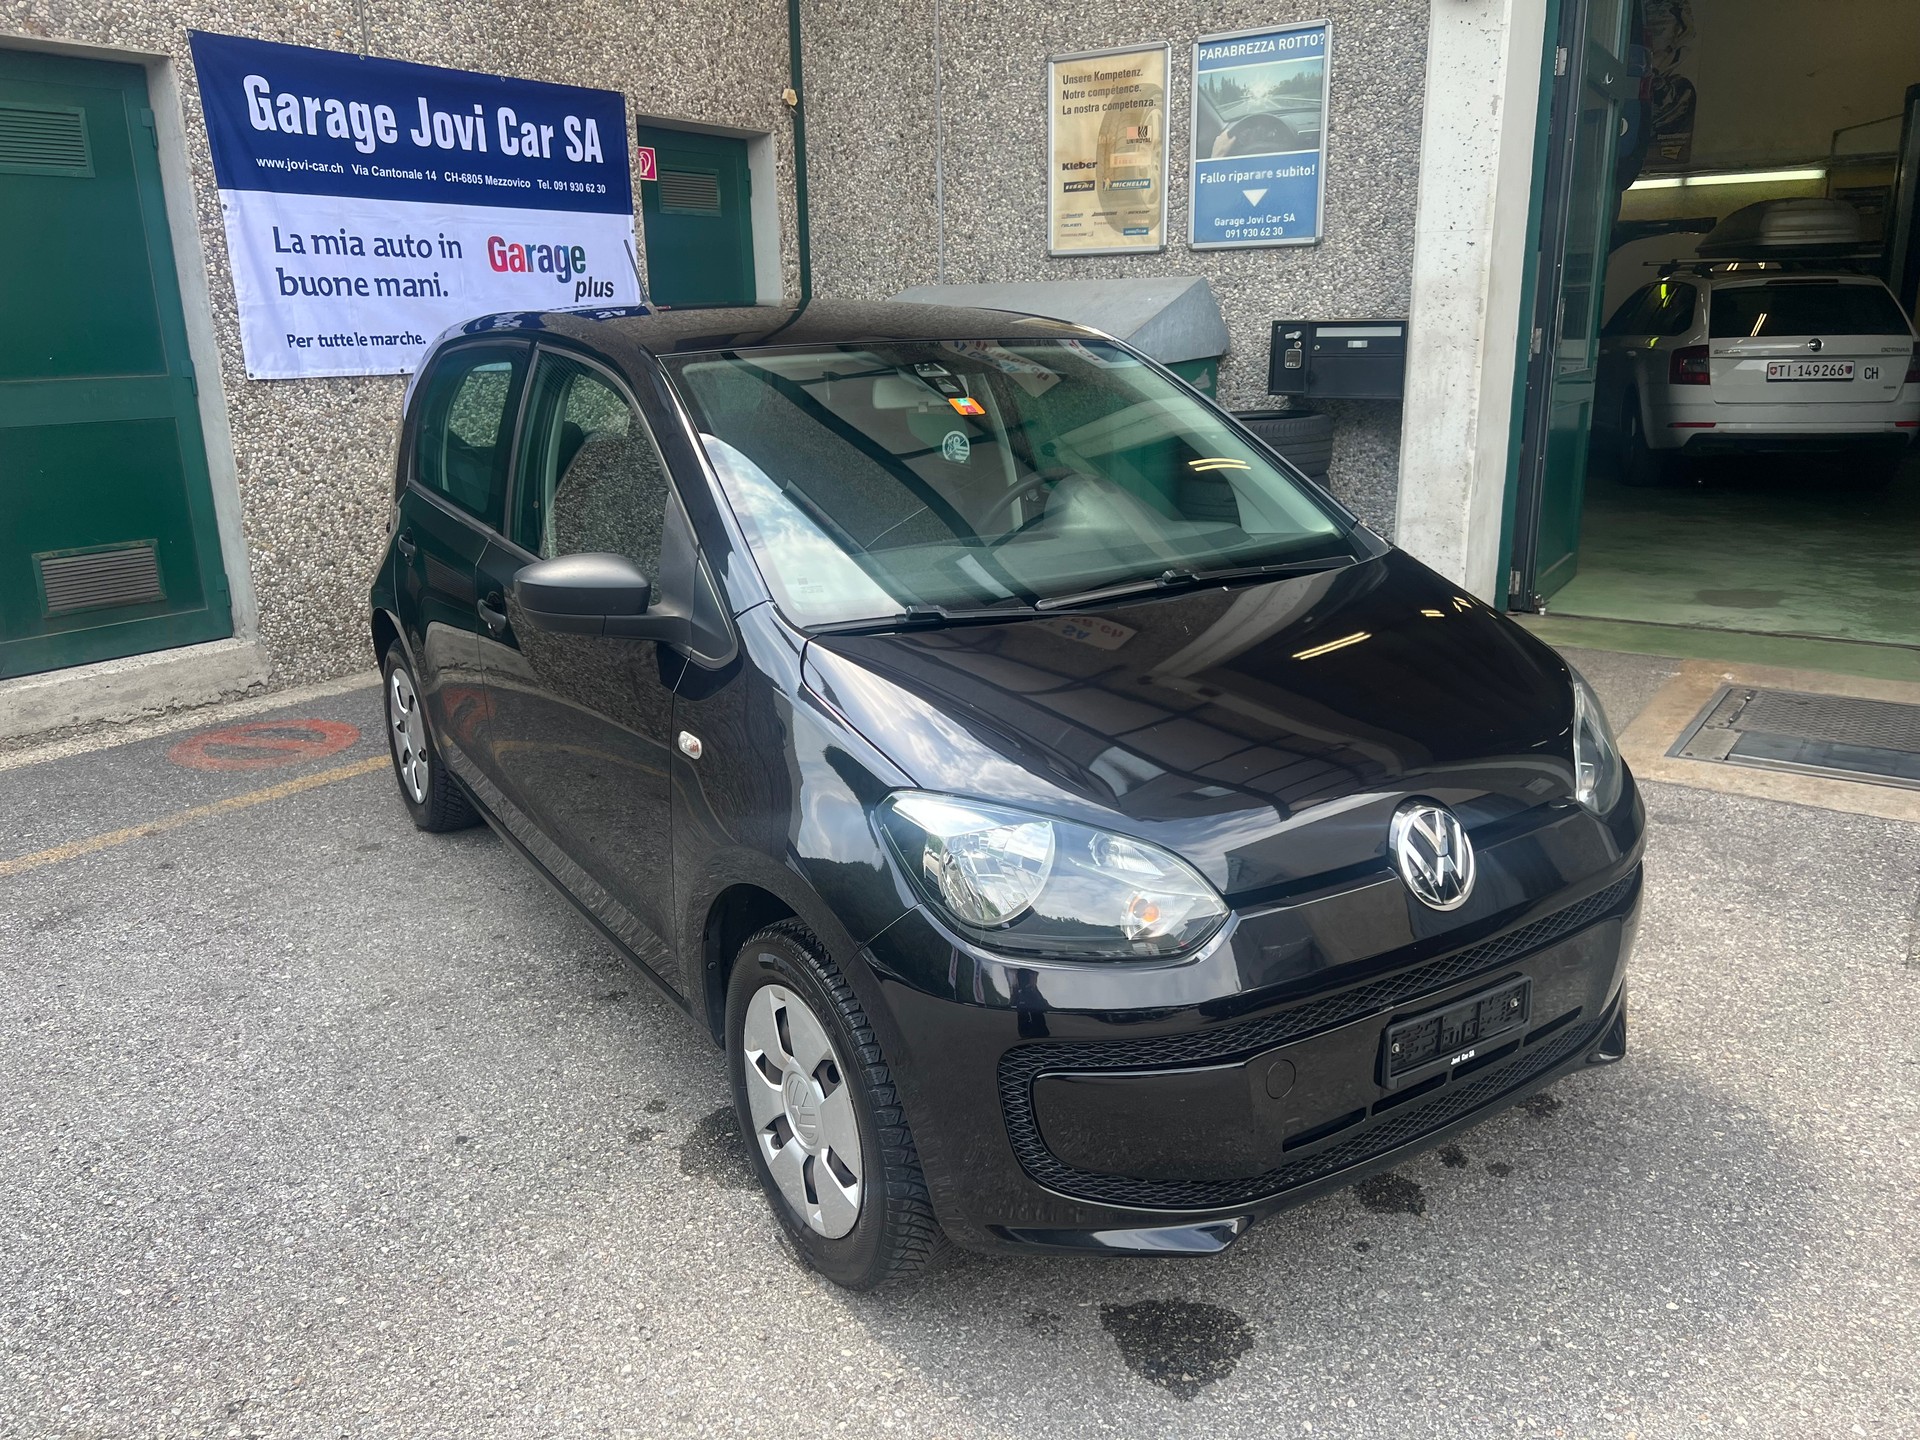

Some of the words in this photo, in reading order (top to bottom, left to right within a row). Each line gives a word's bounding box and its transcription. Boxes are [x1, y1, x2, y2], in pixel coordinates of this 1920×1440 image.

[1199, 39, 1275, 62] PARABREZZA
[1278, 32, 1325, 52] ROTTO?
[1062, 74, 1092, 85] Unsere
[1094, 68, 1143, 82] Kompetenz.
[1062, 89, 1085, 100] Notre
[1087, 84, 1142, 99] compétence.
[1062, 104, 1072, 115] La
[1074, 103, 1100, 114] nostra
[1102, 98, 1157, 111] competenza.
[242, 74, 399, 154] Garage
[410, 97, 488, 153] Jovi
[497, 107, 555, 159] Car
[563, 115, 604, 164] SA
[256, 156, 344, 175] www.jovi-car.ch
[352, 164, 369, 177] Via
[371, 166, 423, 181] Cantonale
[425, 170, 437, 182] 14
[444, 171, 483, 185] CH-6805
[485, 174, 531, 189] Mezzovico
[537, 179, 552, 191] Tel.
[553, 181, 568, 191] 091
[569, 182, 584, 192] 930
[585, 183, 595, 193] 62
[596, 184, 606, 194] 30
[1062, 161, 1098, 171] Kleber
[1200, 172, 1227, 185] Fallo
[1228, 168, 1273, 184] riparare
[1276, 164, 1315, 180] subito!
[1112, 180, 1150, 188] MICHELIN
[1214, 216, 1245, 228] Garage
[1246, 215, 1264, 225] Jovi
[1266, 214, 1282, 224] Car
[1283, 213, 1296, 223] SA
[1225, 228, 1241, 238] 091
[1243, 228, 1258, 238] 930
[1260, 228, 1271, 237] 62
[1272, 227, 1283, 236] 30
[272, 225, 307, 255] La
[311, 227, 365, 258] mia
[373, 234, 433, 260] auto
[438, 232, 463, 260] in
[487, 236, 586, 284] Garage
[276, 267, 370, 298] buone
[374, 272, 449, 299] mani.
[575, 276, 615, 303] plus
[286, 333, 313, 349] Per
[317, 333, 354, 348] tutte
[354, 331, 368, 346] le
[370, 331, 427, 347] marche.
[1864, 366, 1879, 380] CH
